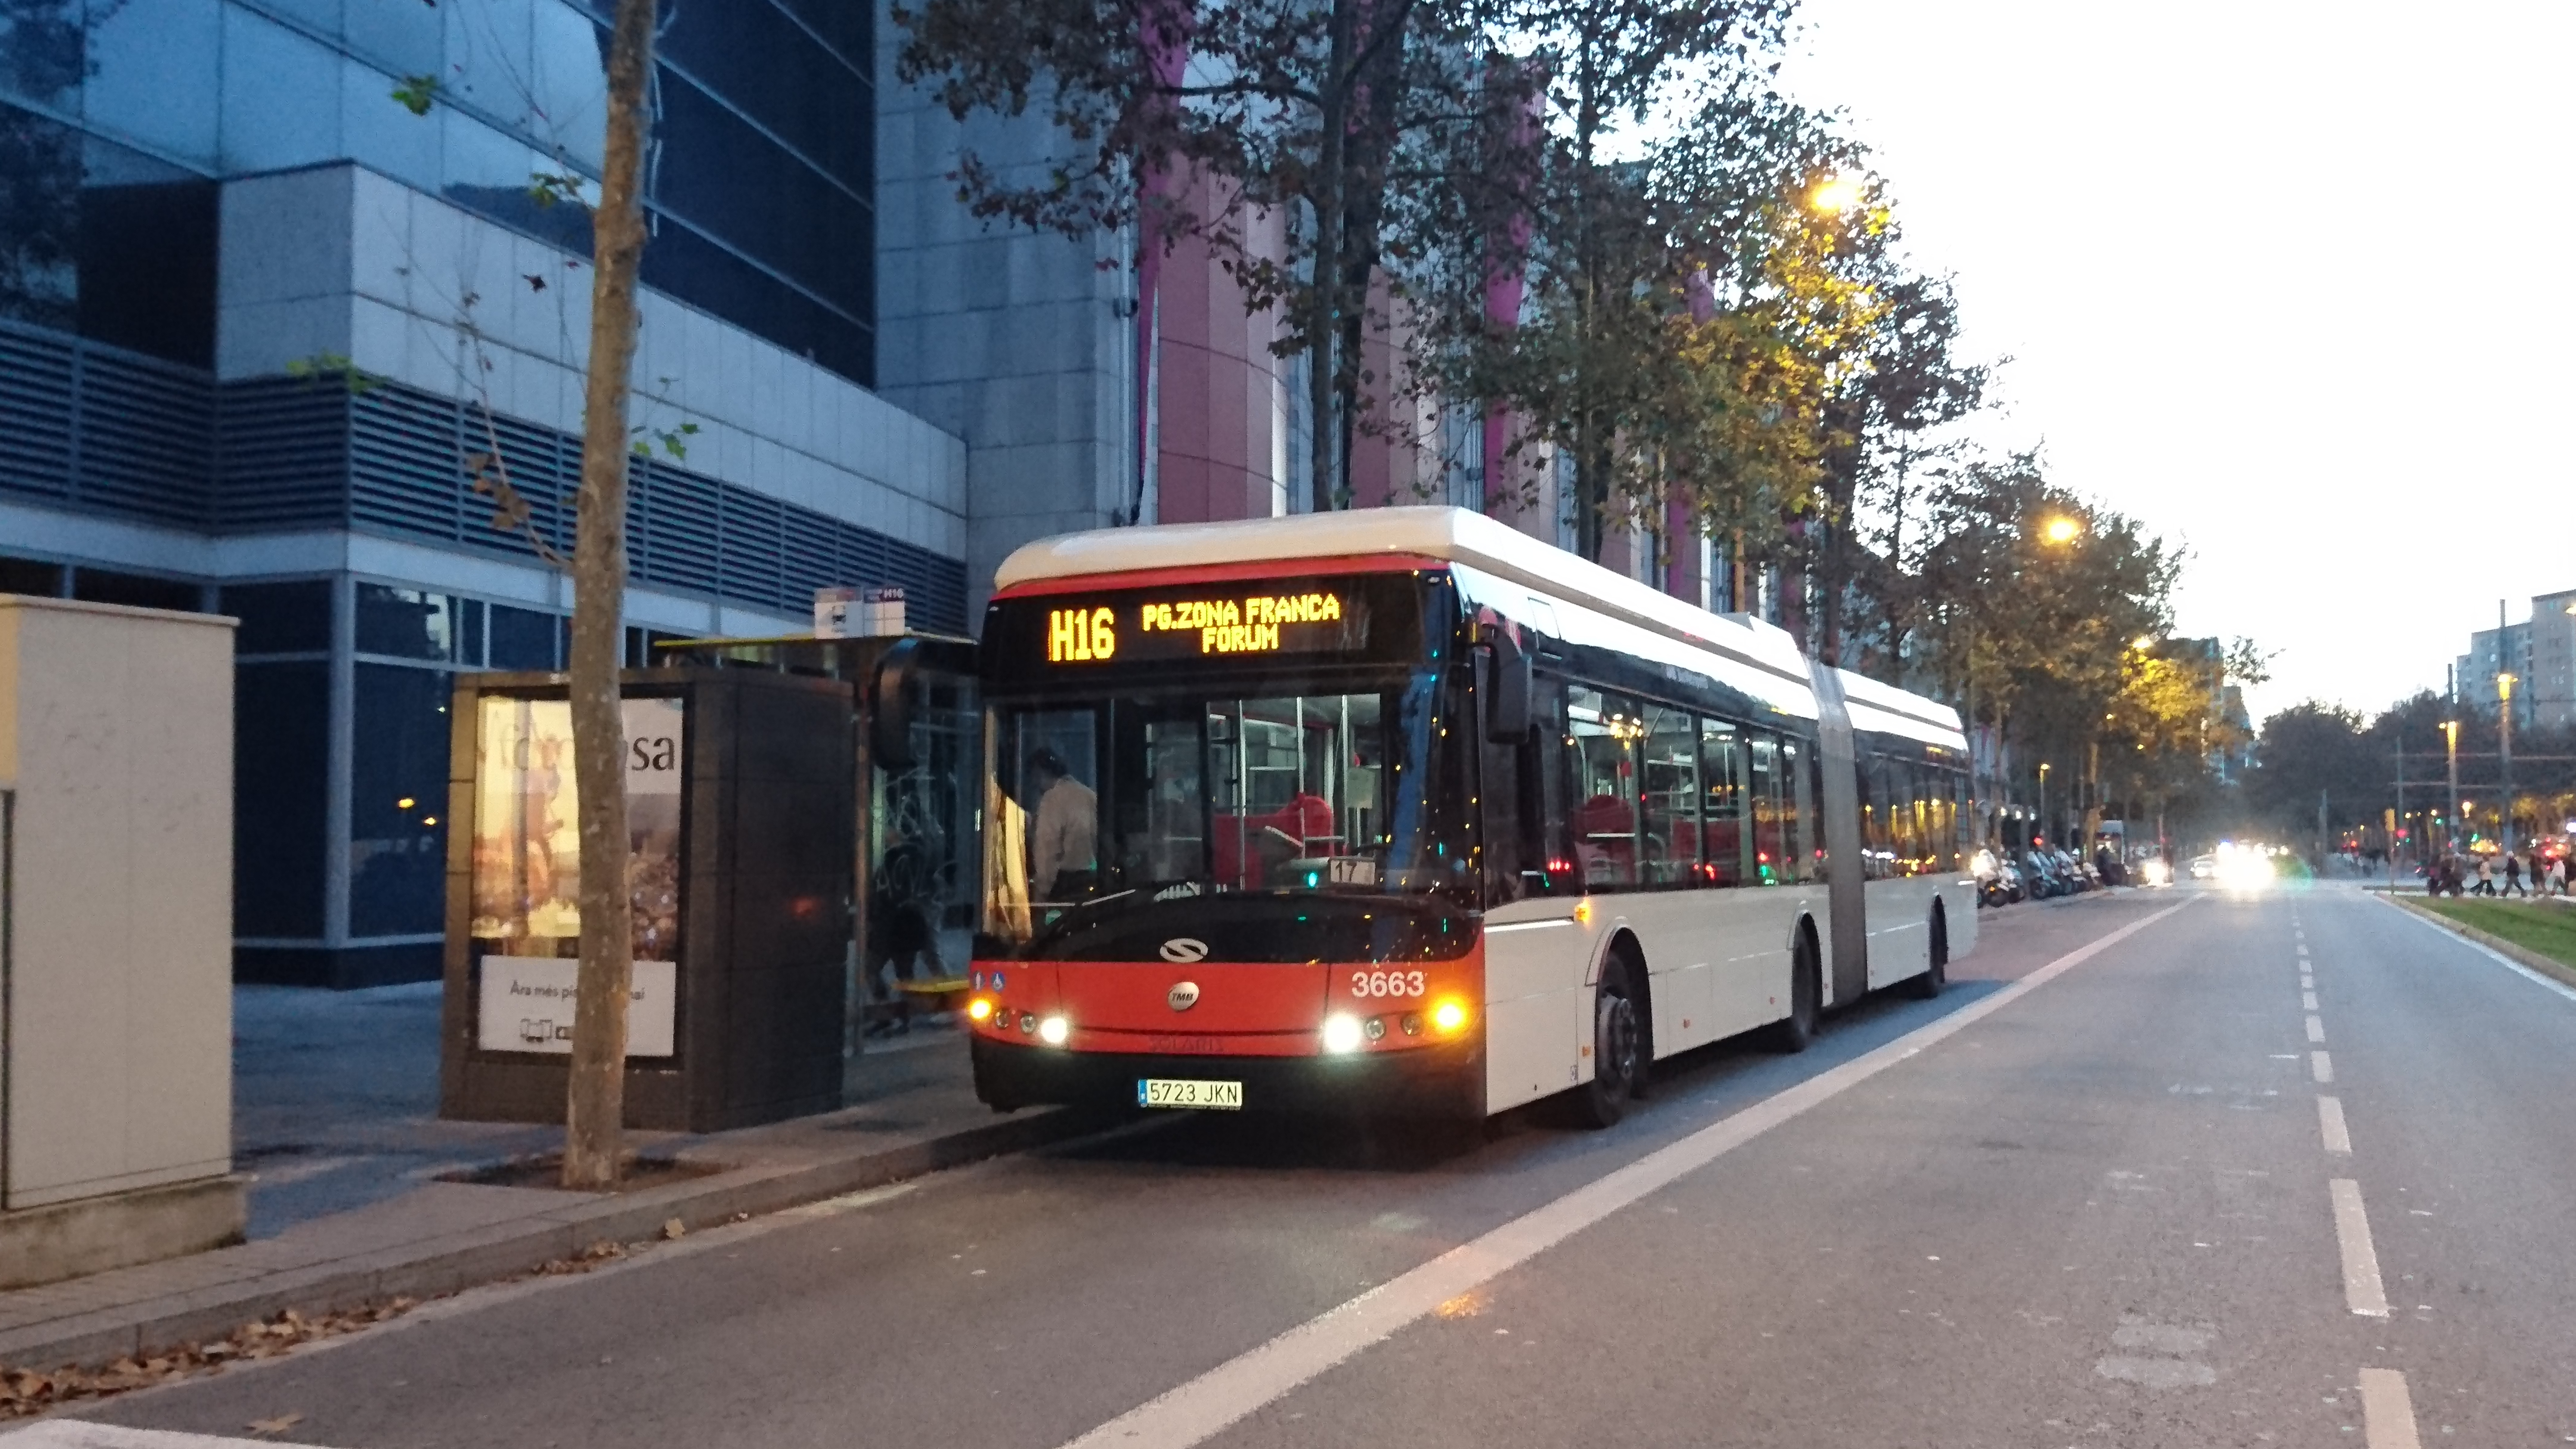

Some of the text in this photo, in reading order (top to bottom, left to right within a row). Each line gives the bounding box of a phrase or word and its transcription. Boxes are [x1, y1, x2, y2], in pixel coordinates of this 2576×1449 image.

[1142, 593, 1340, 631] PG.ZONA FRANCA
[1049, 607, 1115, 661] H16
[1202, 623, 1279, 653] FORUM
[1336, 861, 1357, 882] 17
[1352, 971, 1425, 998] 3663
[1150, 1083, 1237, 1103] 5723 JKN
